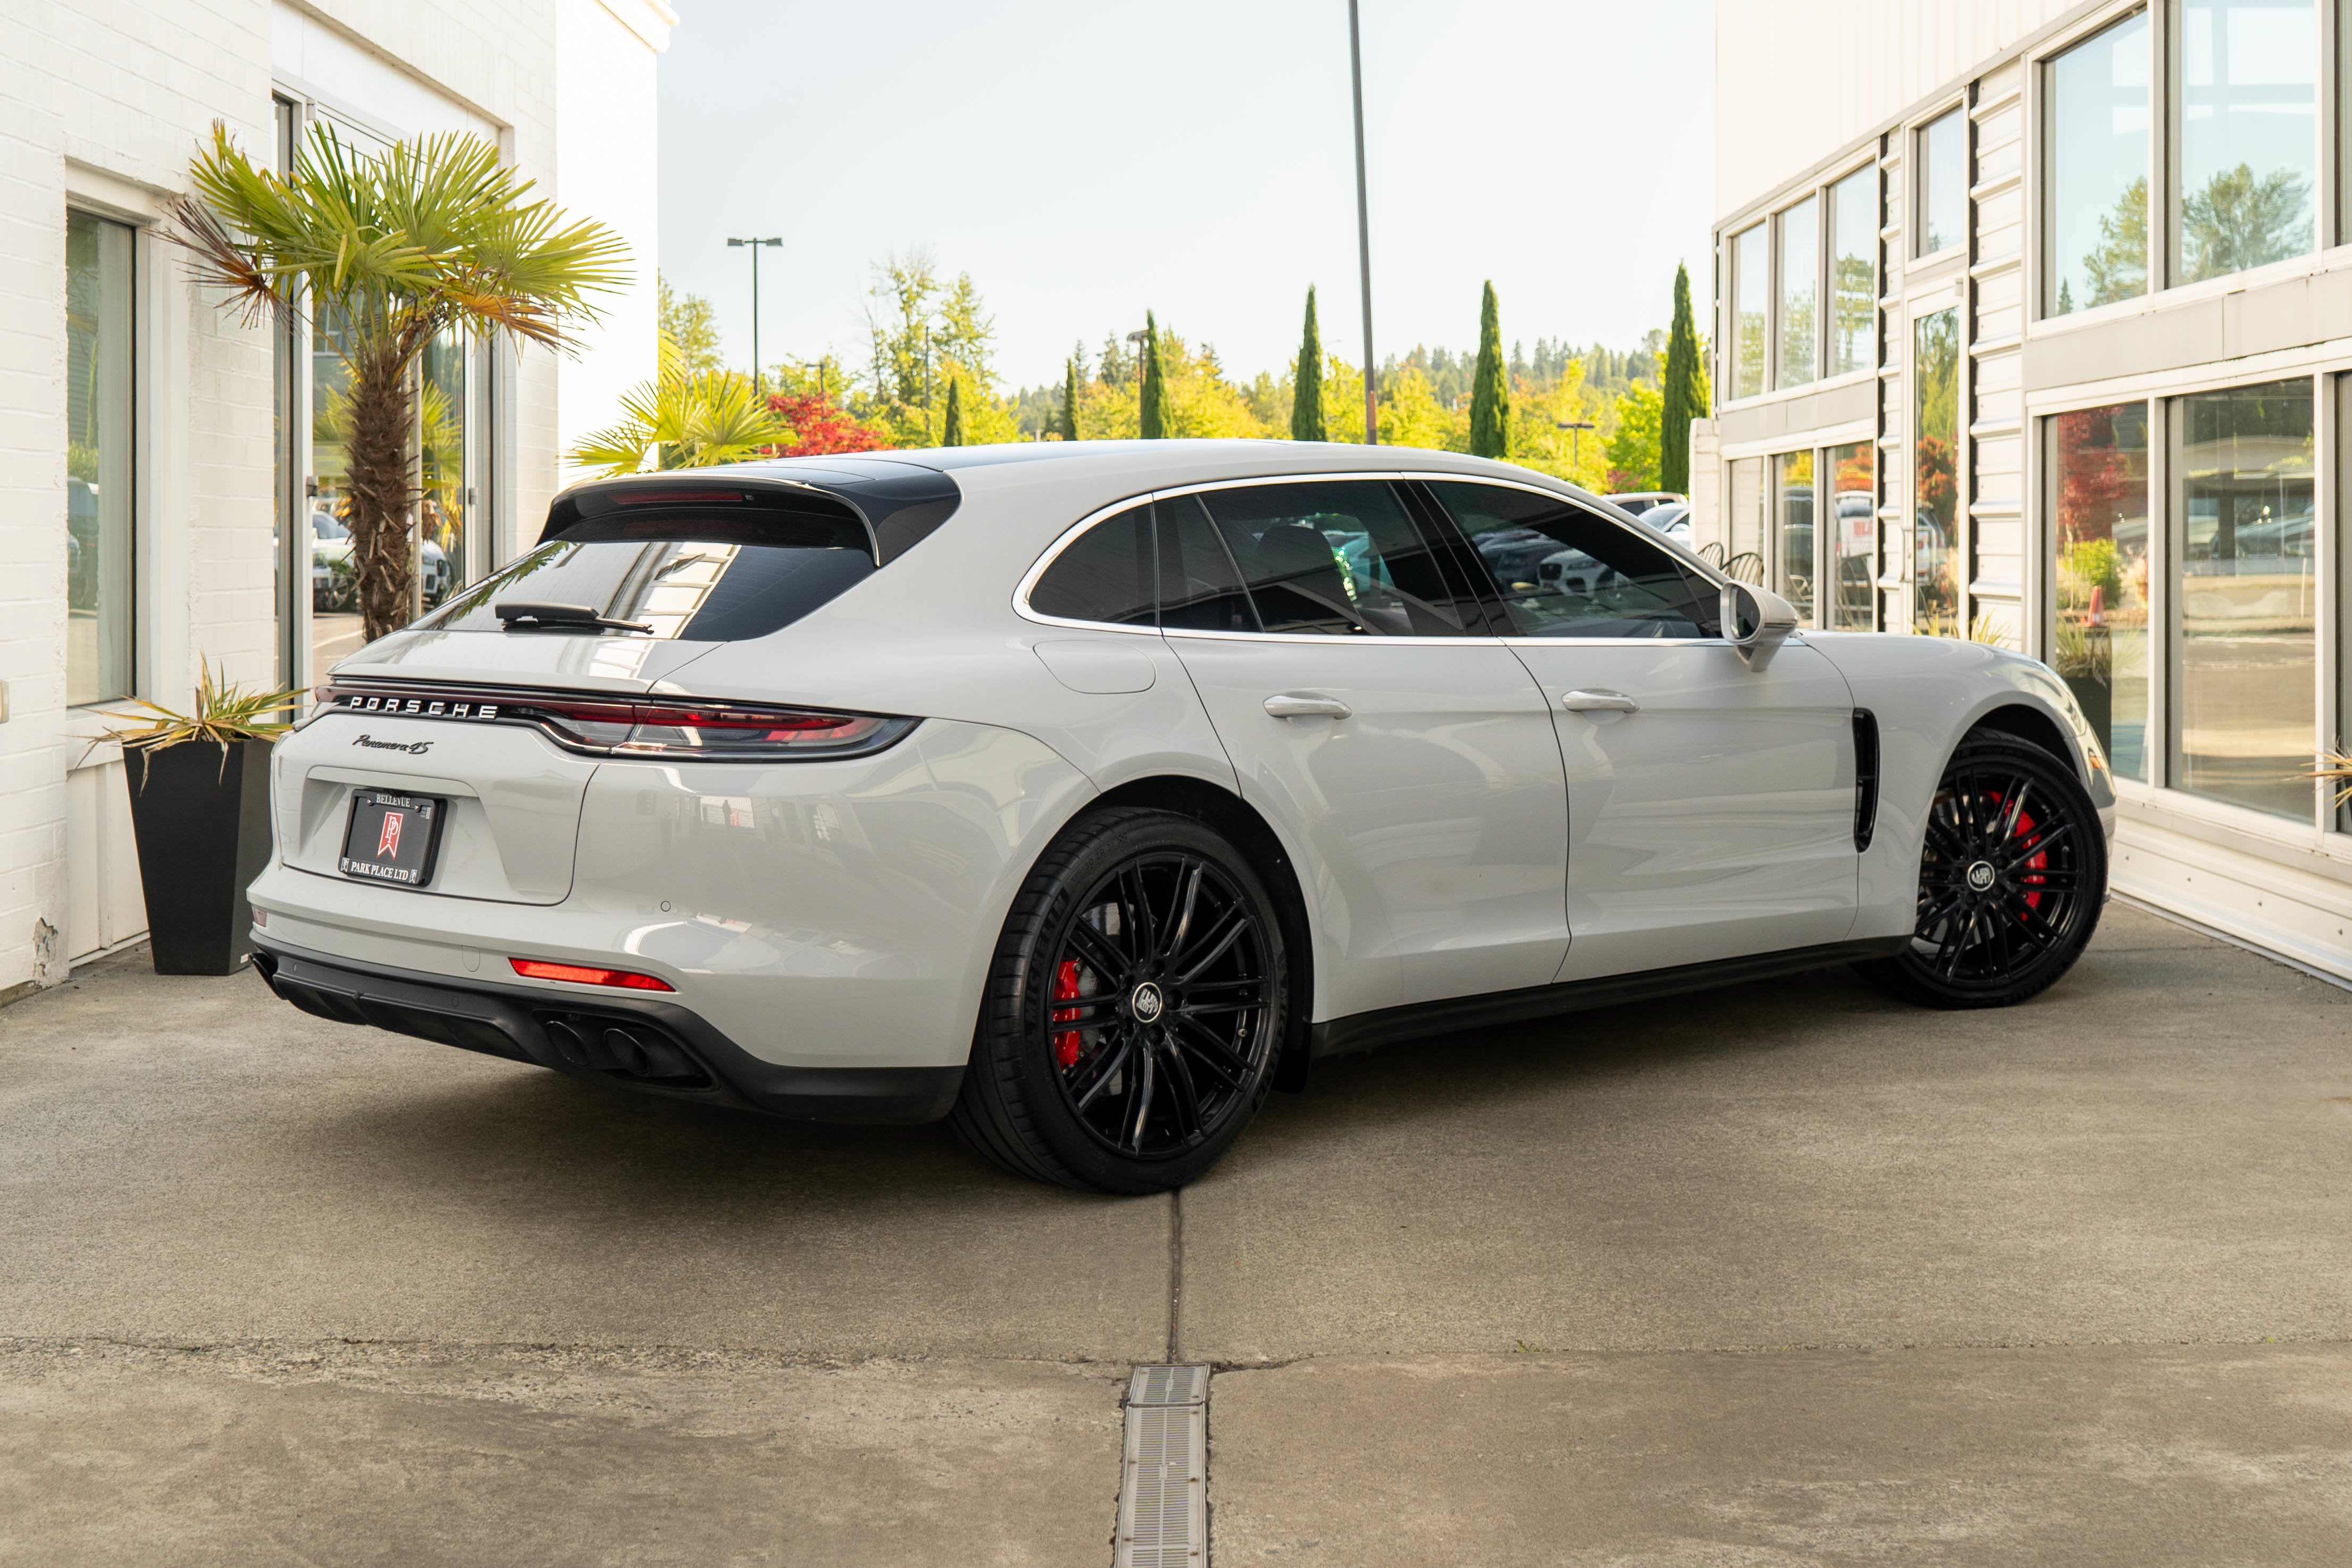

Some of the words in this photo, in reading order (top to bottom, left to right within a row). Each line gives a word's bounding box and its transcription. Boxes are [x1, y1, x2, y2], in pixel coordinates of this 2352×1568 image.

[350, 697, 498, 719] PORSCHE
[352, 734, 407, 751] Panamera
[408, 742, 434, 754] 4S
[376, 794, 411, 807] BELLEVUE
[350, 861, 372, 875] PARK
[371, 864, 395, 878] PLACE
[394, 868, 409, 881] LTD
